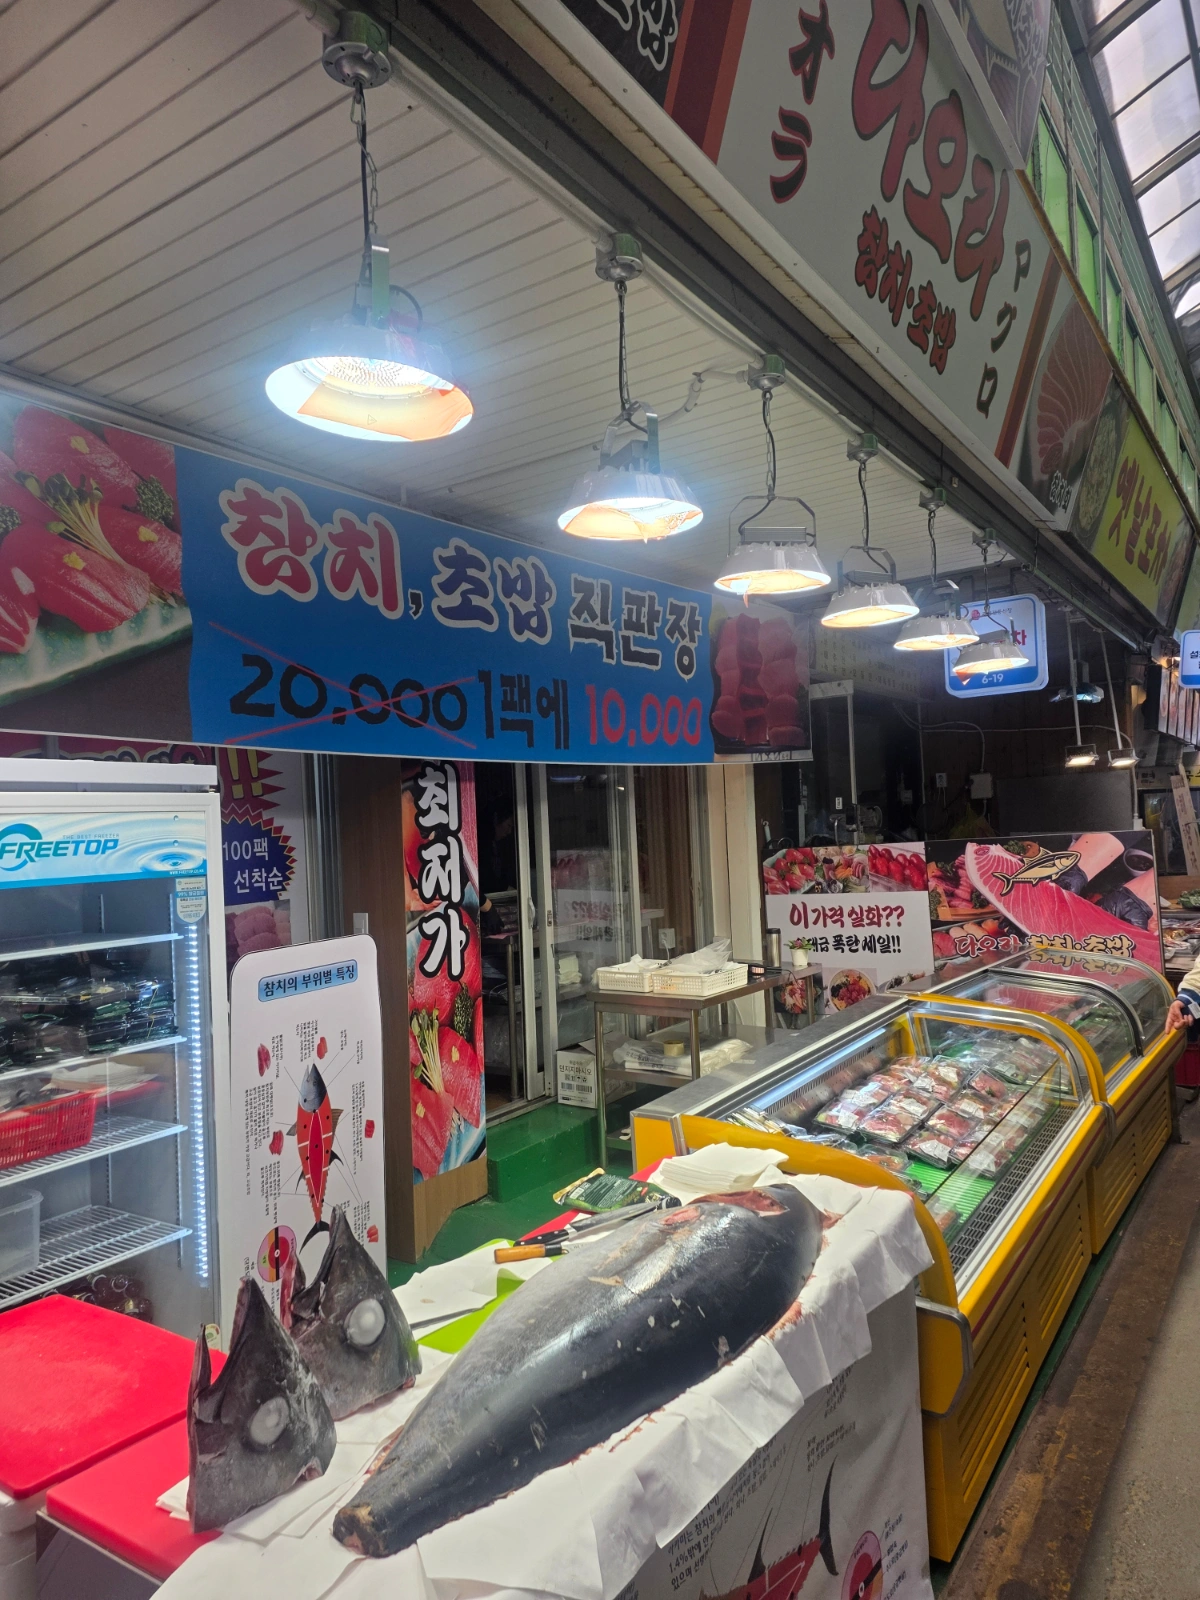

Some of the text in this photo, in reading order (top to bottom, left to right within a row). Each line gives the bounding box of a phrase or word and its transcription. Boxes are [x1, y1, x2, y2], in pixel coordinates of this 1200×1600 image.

[1108, 456, 1172, 586] 옛날포차
[431, 537, 559, 646] 초밥
[568, 573, 703, 682] 직판장
[981, 673, 1004, 684] 6-19
[478, 667, 570, 751] 1팩에
[0, 838, 120, 863] FREETOP
[234, 866, 284, 895] 선착순
[417, 762, 468, 978] 최저가
[789, 902, 906, 930] 이 가격 실화??
[832, 934, 861, 954] 폭탄
[862, 934, 902, 954] 세일!!
[263, 964, 355, 997] 참치의 부위별 특징
[671, 1565, 693, 1591] 있으며
